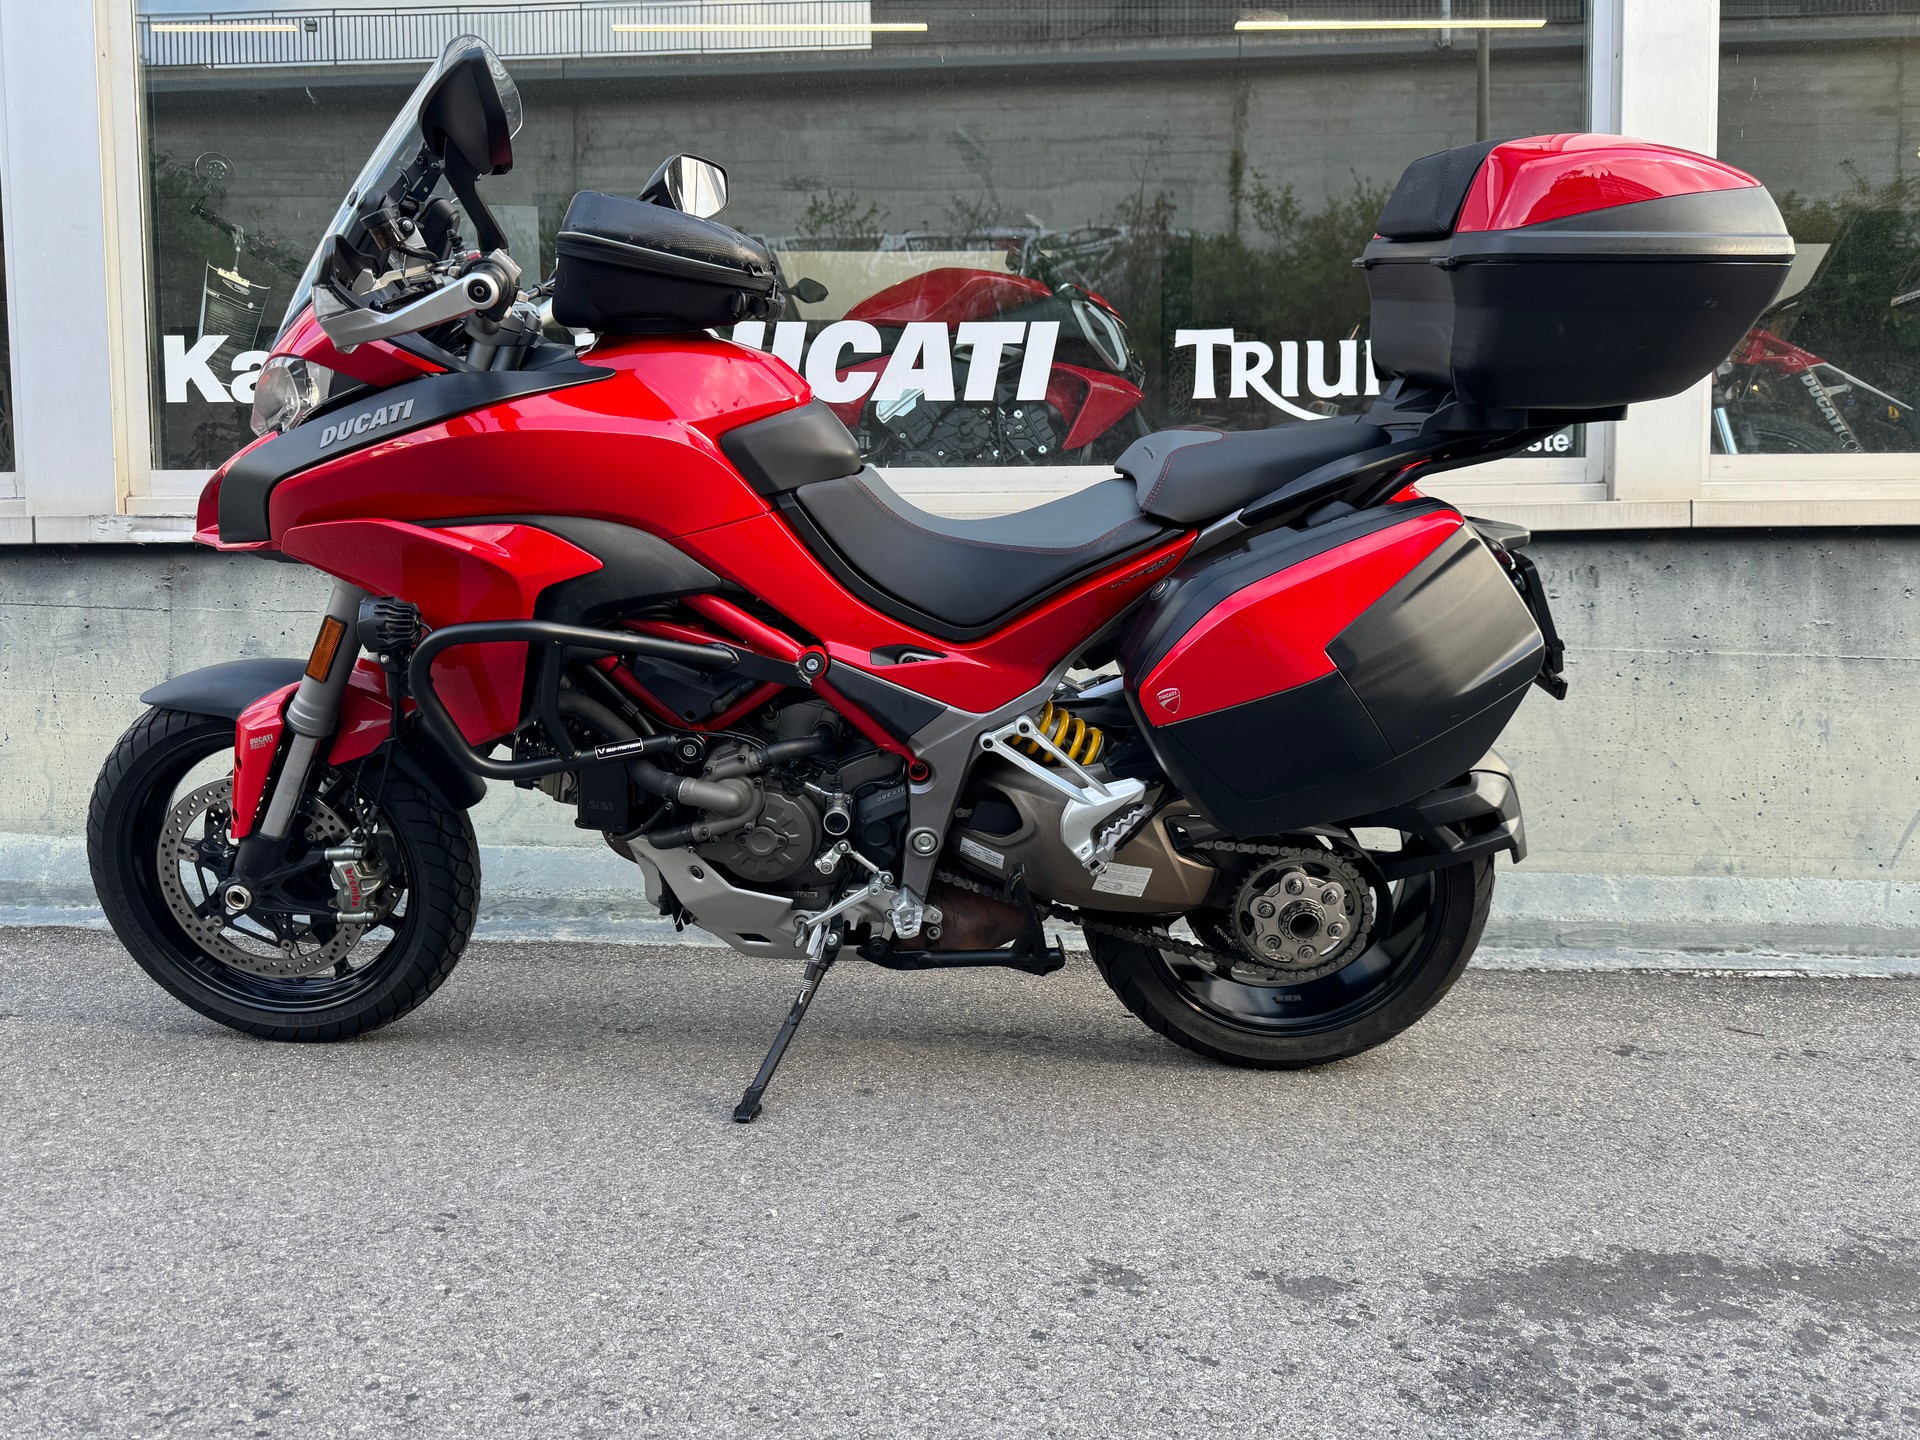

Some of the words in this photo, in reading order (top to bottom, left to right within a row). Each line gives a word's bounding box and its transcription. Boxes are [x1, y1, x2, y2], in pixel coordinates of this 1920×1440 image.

[704, 321, 1060, 404] UCATI
[1800, 373, 1847, 433] DUCATI
[319, 398, 415, 449] DUCATI
[1521, 433, 1569, 452] ste
[1158, 690, 1177, 700] DUCATI
[250, 733, 274, 745] DUCATI
[345, 868, 362, 907] brembo
